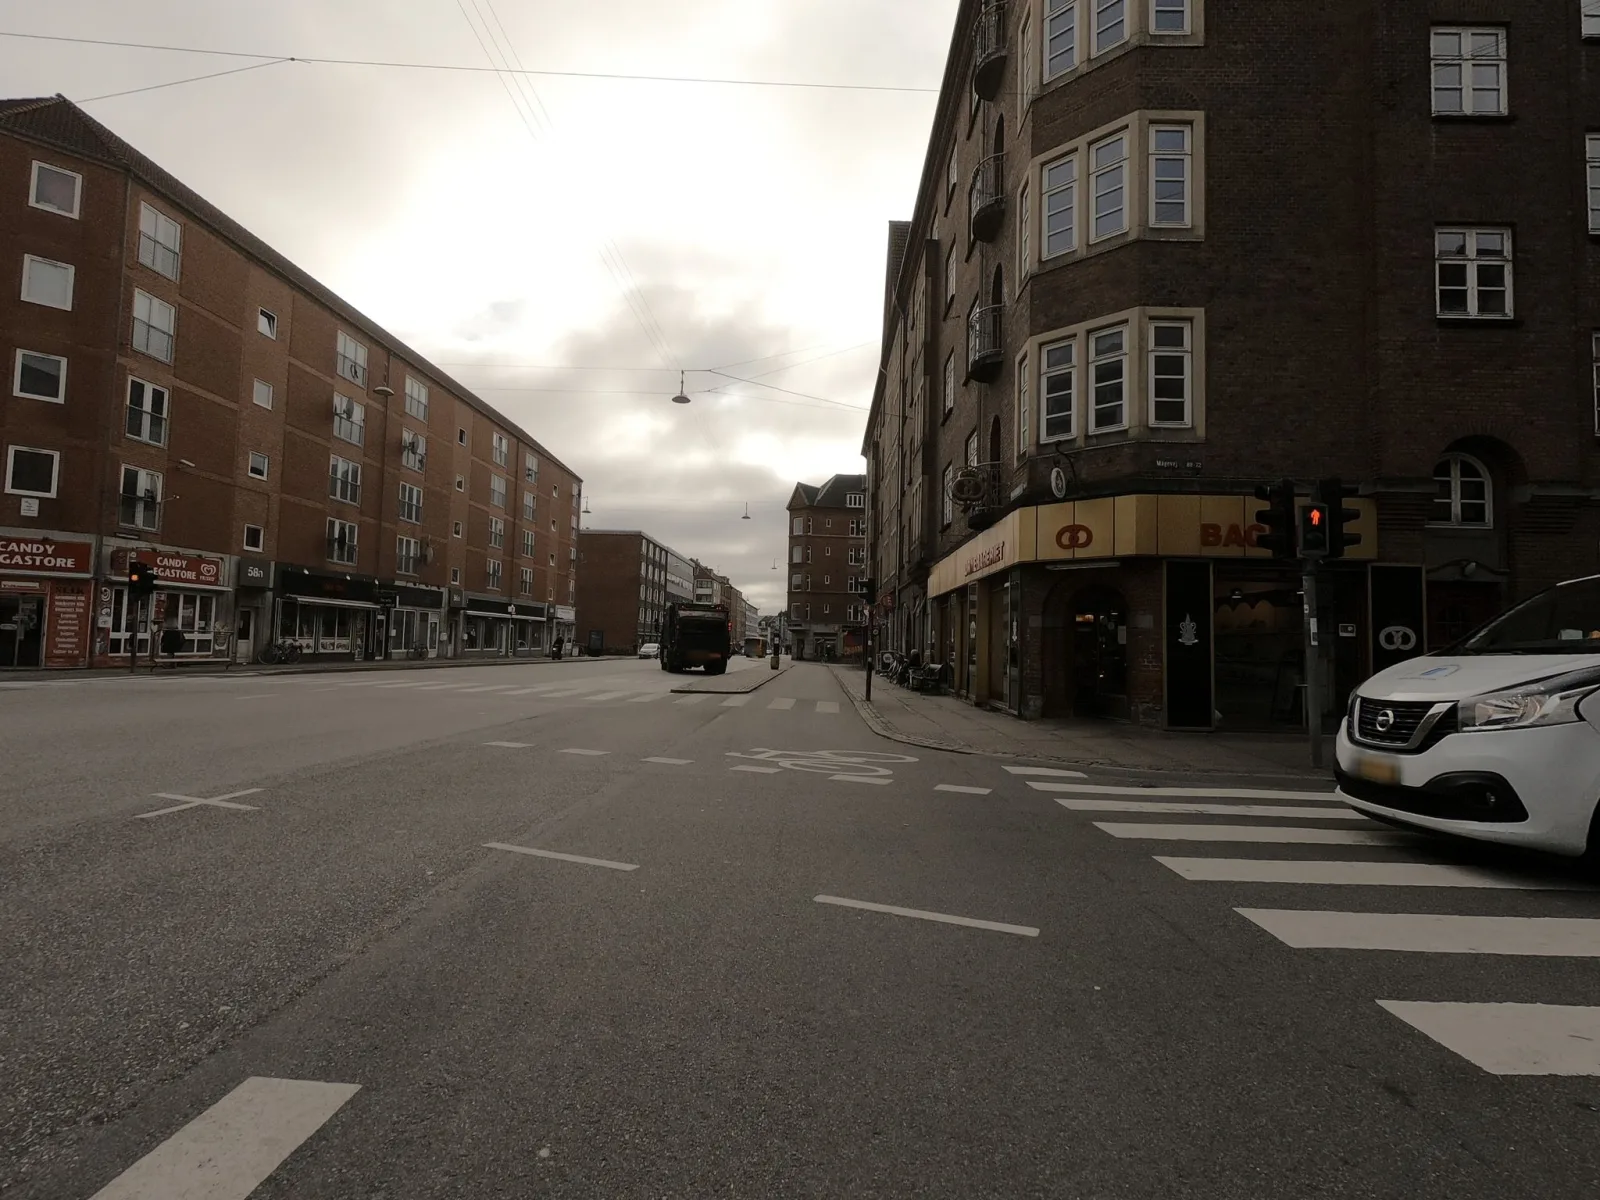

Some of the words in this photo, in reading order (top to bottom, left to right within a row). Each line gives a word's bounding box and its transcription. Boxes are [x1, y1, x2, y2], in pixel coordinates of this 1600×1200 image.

[0, 541, 55, 554] CANDY
[156, 556, 187, 569] CANDY
[152, 566, 197, 580] EGASTORE
